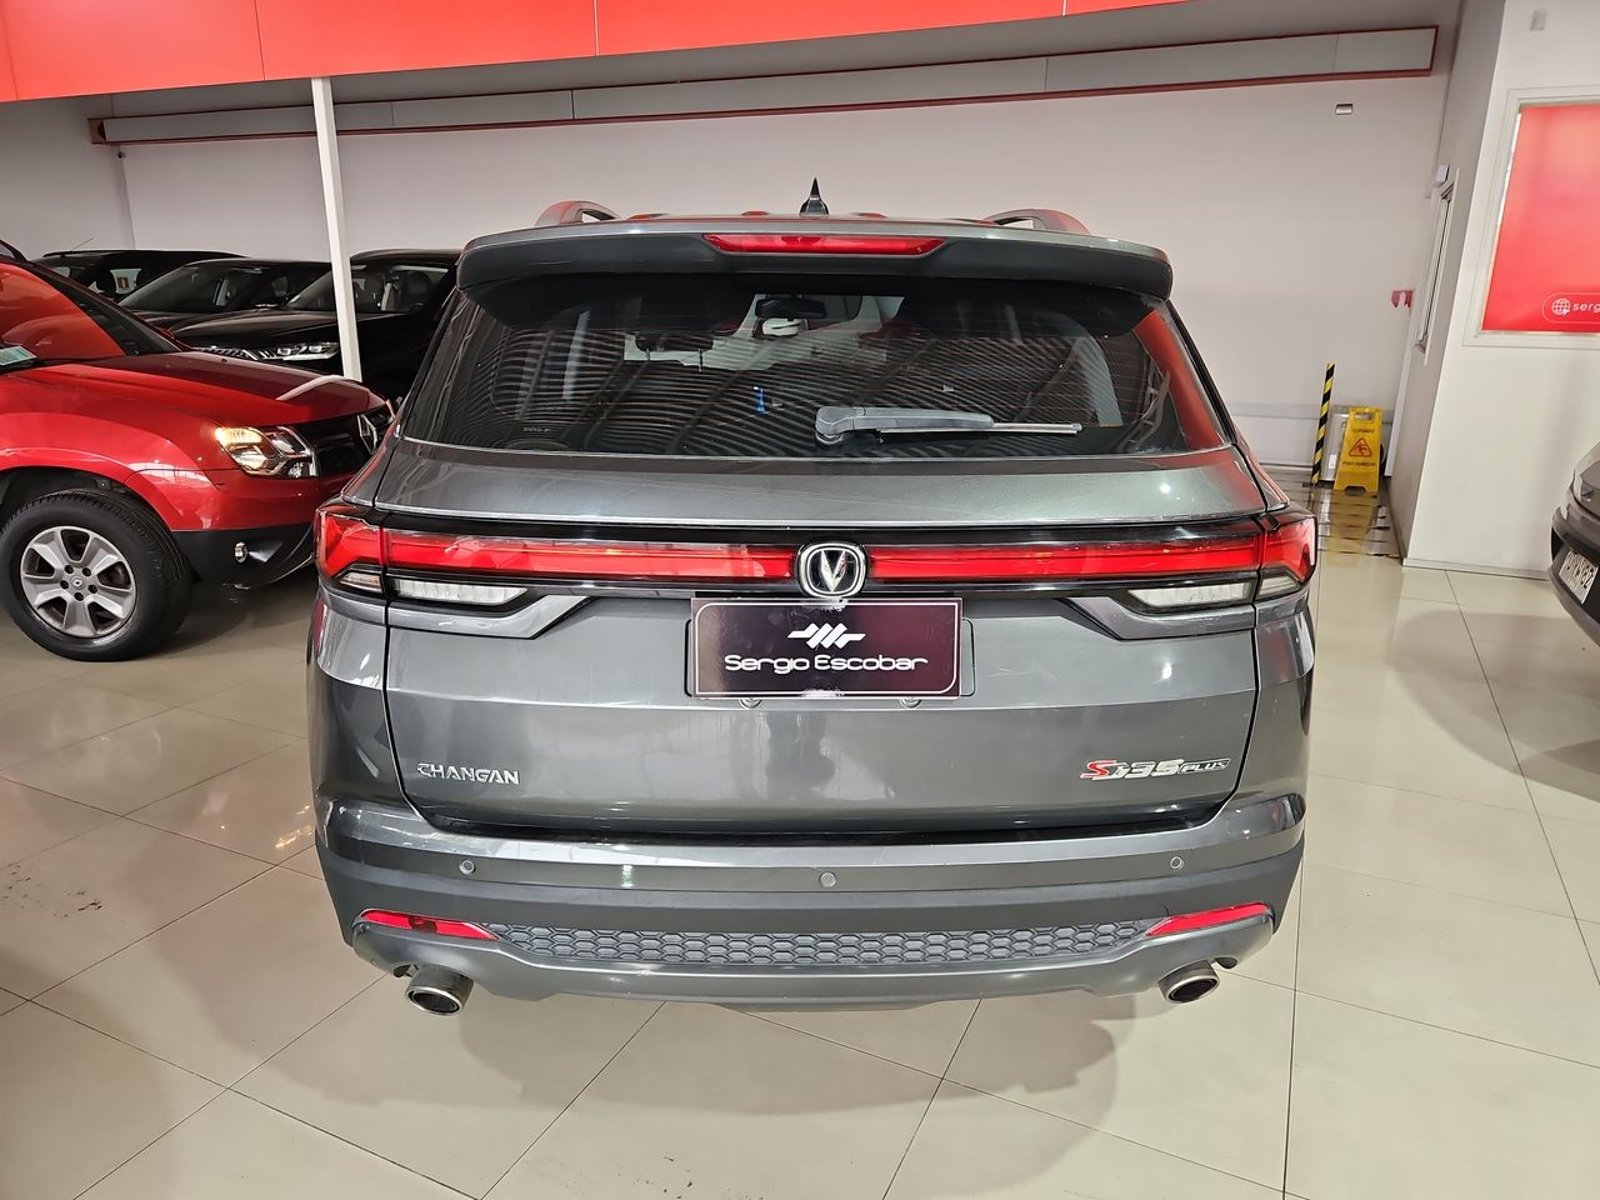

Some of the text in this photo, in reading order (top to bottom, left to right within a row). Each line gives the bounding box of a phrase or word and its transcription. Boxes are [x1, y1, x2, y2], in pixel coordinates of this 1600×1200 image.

[724, 654, 928, 675] Sergio Escobar
[417, 763, 520, 785] CHANGAN
